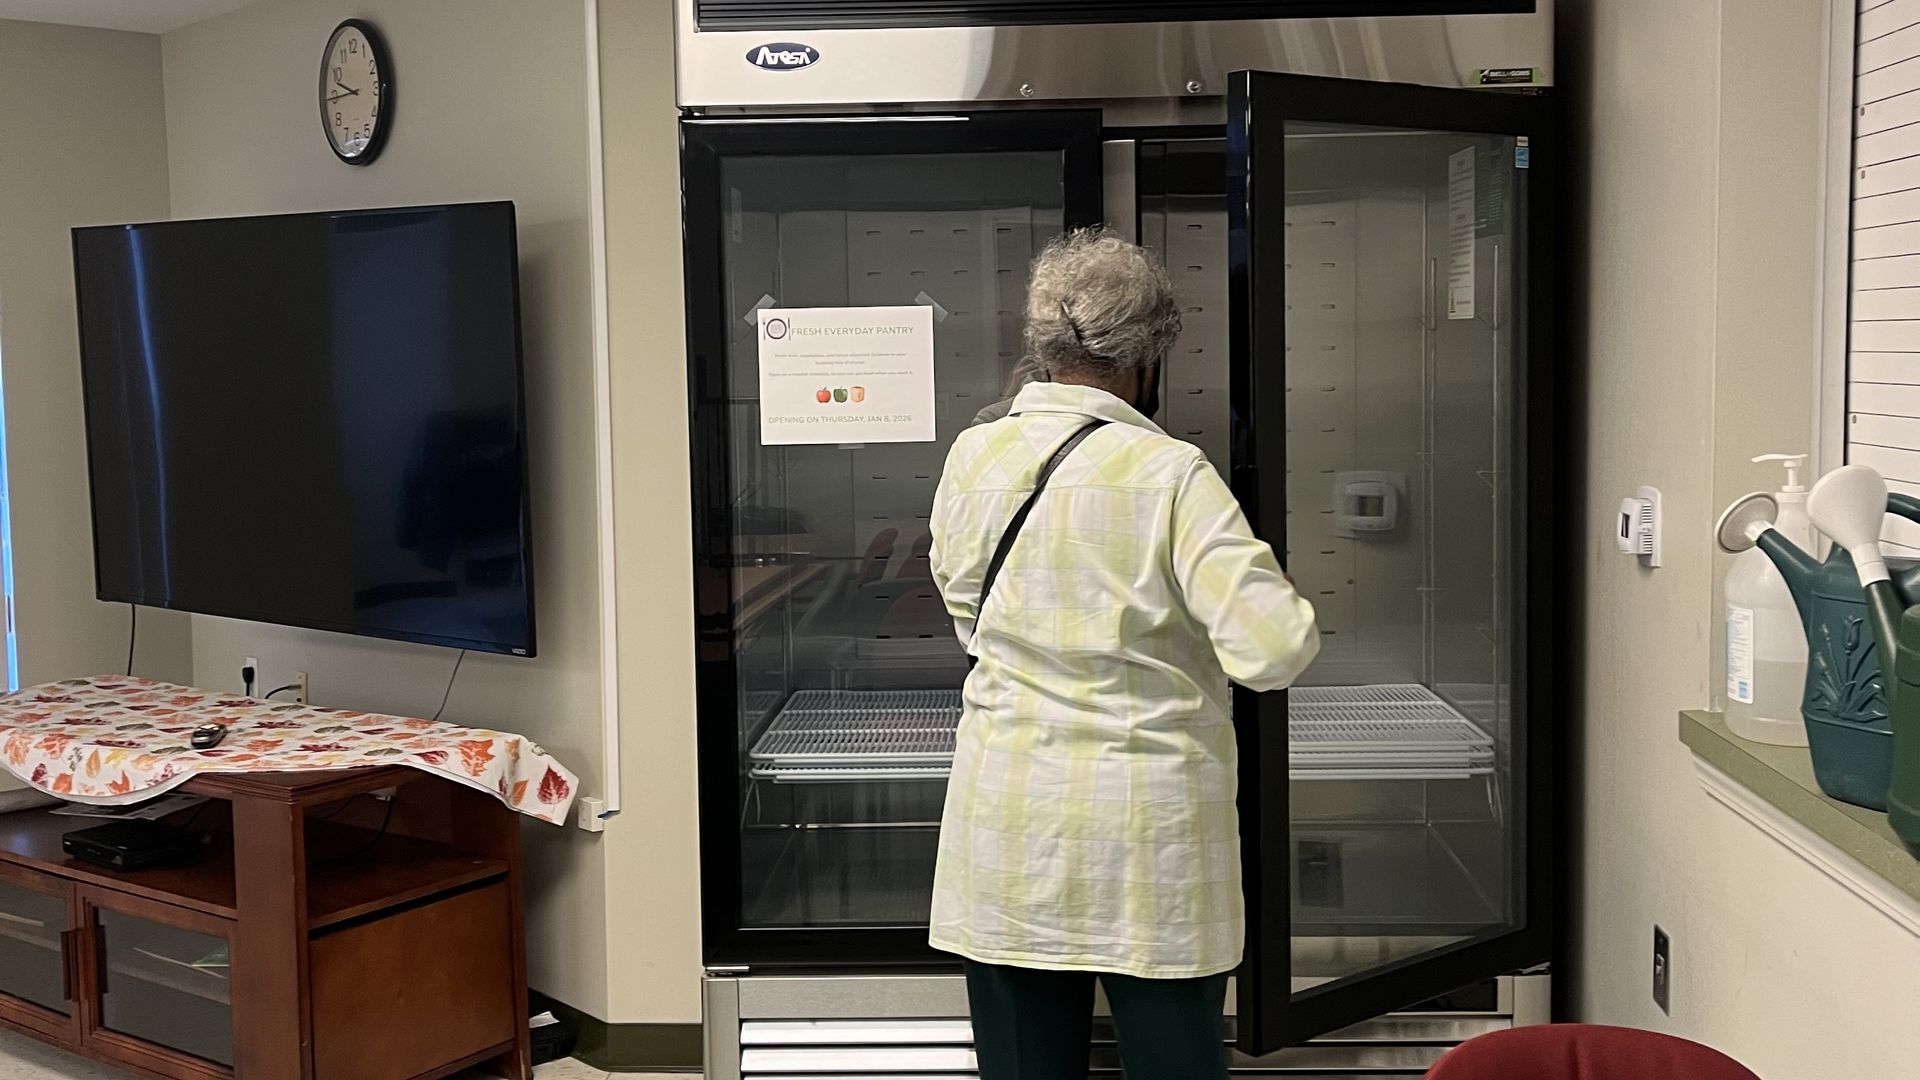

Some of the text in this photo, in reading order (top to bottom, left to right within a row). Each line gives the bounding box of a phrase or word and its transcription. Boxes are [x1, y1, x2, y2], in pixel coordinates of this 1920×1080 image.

[348, 38, 358, 54] 12
[341, 48, 348, 64] 11
[333, 66, 342, 82] 10
[369, 59, 376, 75] 2
[372, 81, 379, 97] 3
[335, 112, 342, 127] 8
[371, 105, 377, 118] 4
[343, 127, 350, 142] 7
[353, 131, 361, 147] 6
[364, 123, 371, 139] 5
[791, 327, 822, 336] FRESH
[824, 326, 874, 336] EVERYDAY
[876, 326, 914, 335] PANTRY
[768, 416, 805, 424] OPENING
[807, 416, 820, 424] ON
[821, 415, 866, 424] THURSDAY,
[867, 415, 882, 423] JAN
[893, 414, 913, 423] 2026
